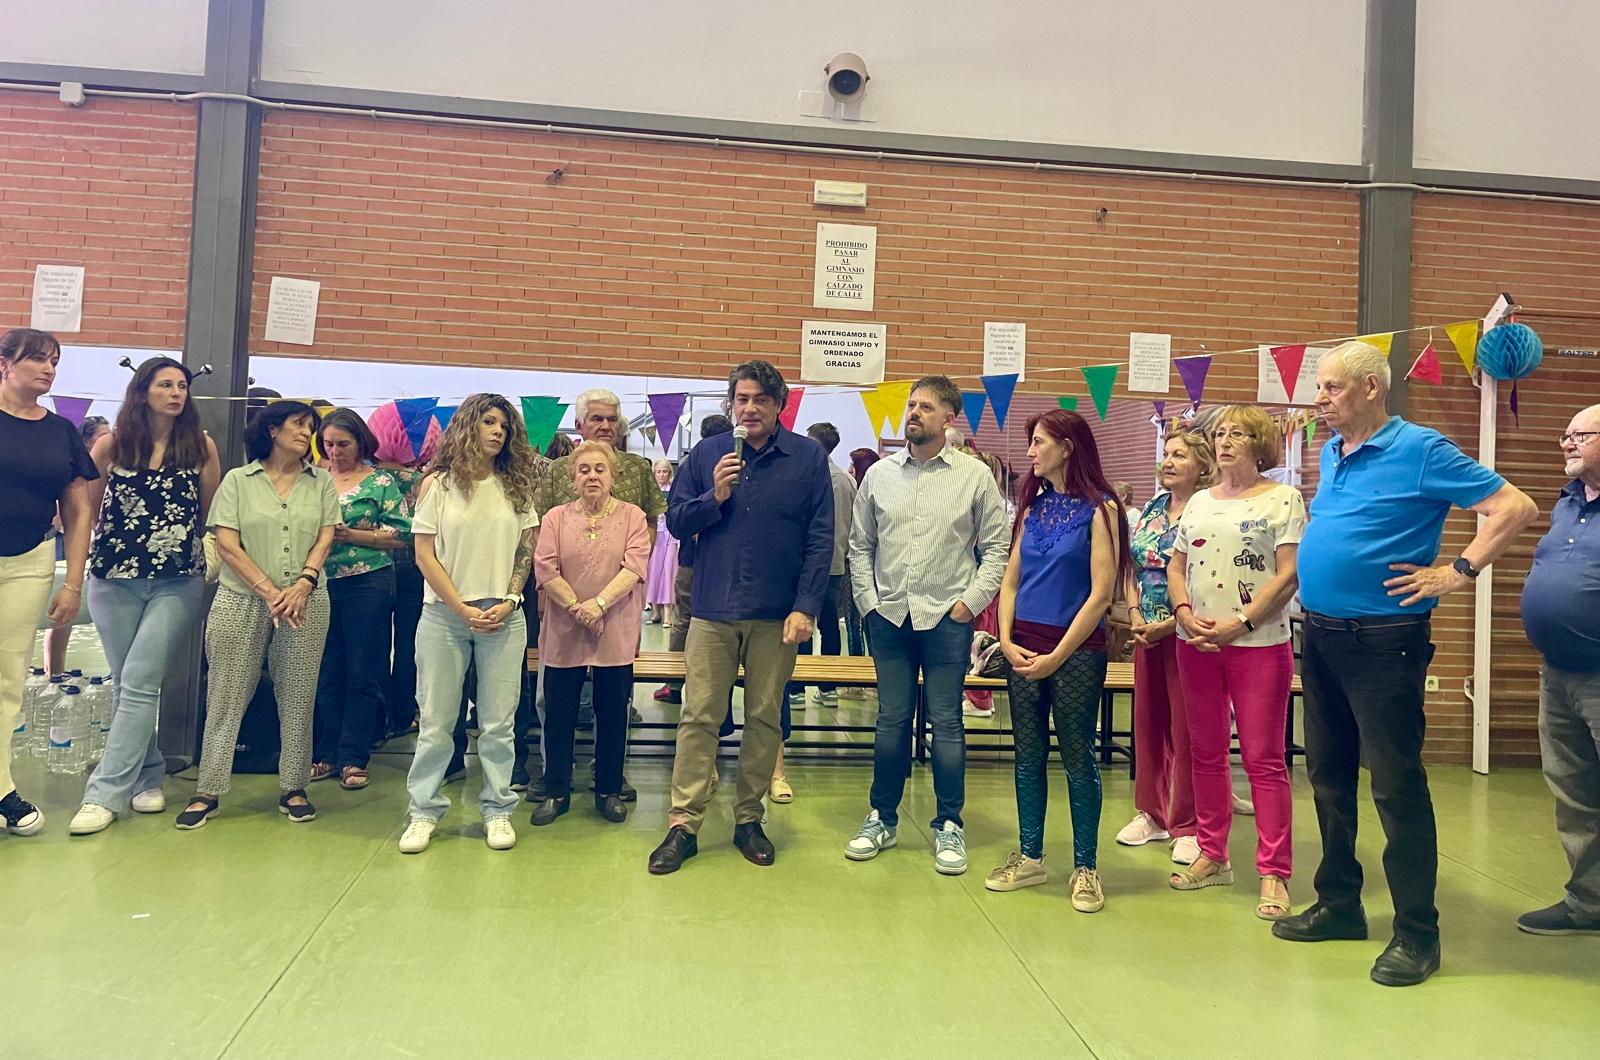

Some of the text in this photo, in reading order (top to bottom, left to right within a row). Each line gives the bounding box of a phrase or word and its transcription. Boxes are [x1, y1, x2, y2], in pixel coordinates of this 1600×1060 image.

[826, 240, 868, 249] PROHIBIDO
[834, 249, 858, 257] PASAR
[826, 265, 865, 274] GIMNASIO
[826, 282, 863, 290] CALZADO
[810, 330, 867, 338] MANTENGAMOS
